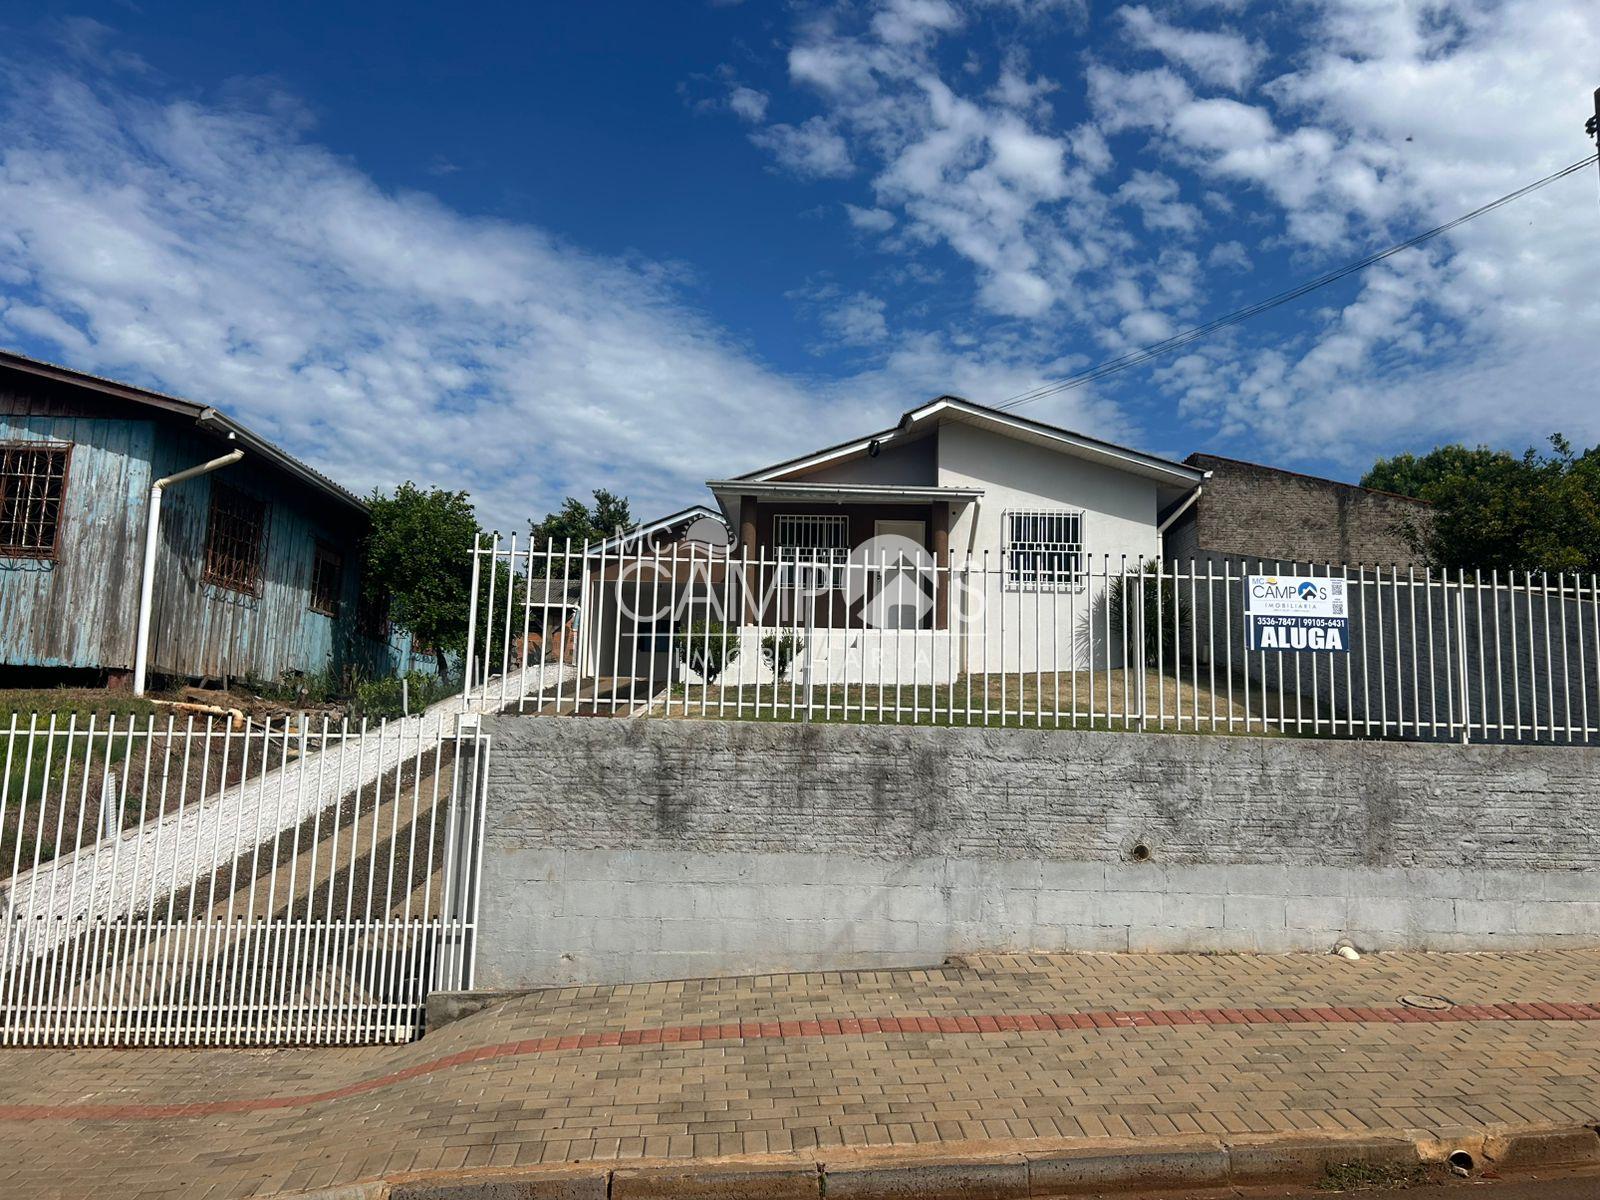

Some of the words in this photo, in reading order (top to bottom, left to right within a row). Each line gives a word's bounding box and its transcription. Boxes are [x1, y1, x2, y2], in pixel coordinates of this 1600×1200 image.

[1257, 617, 1296, 626] 3536-7847
[1303, 618, 1345, 628] 99105-6431
[1260, 626, 1343, 650] ALUGA
